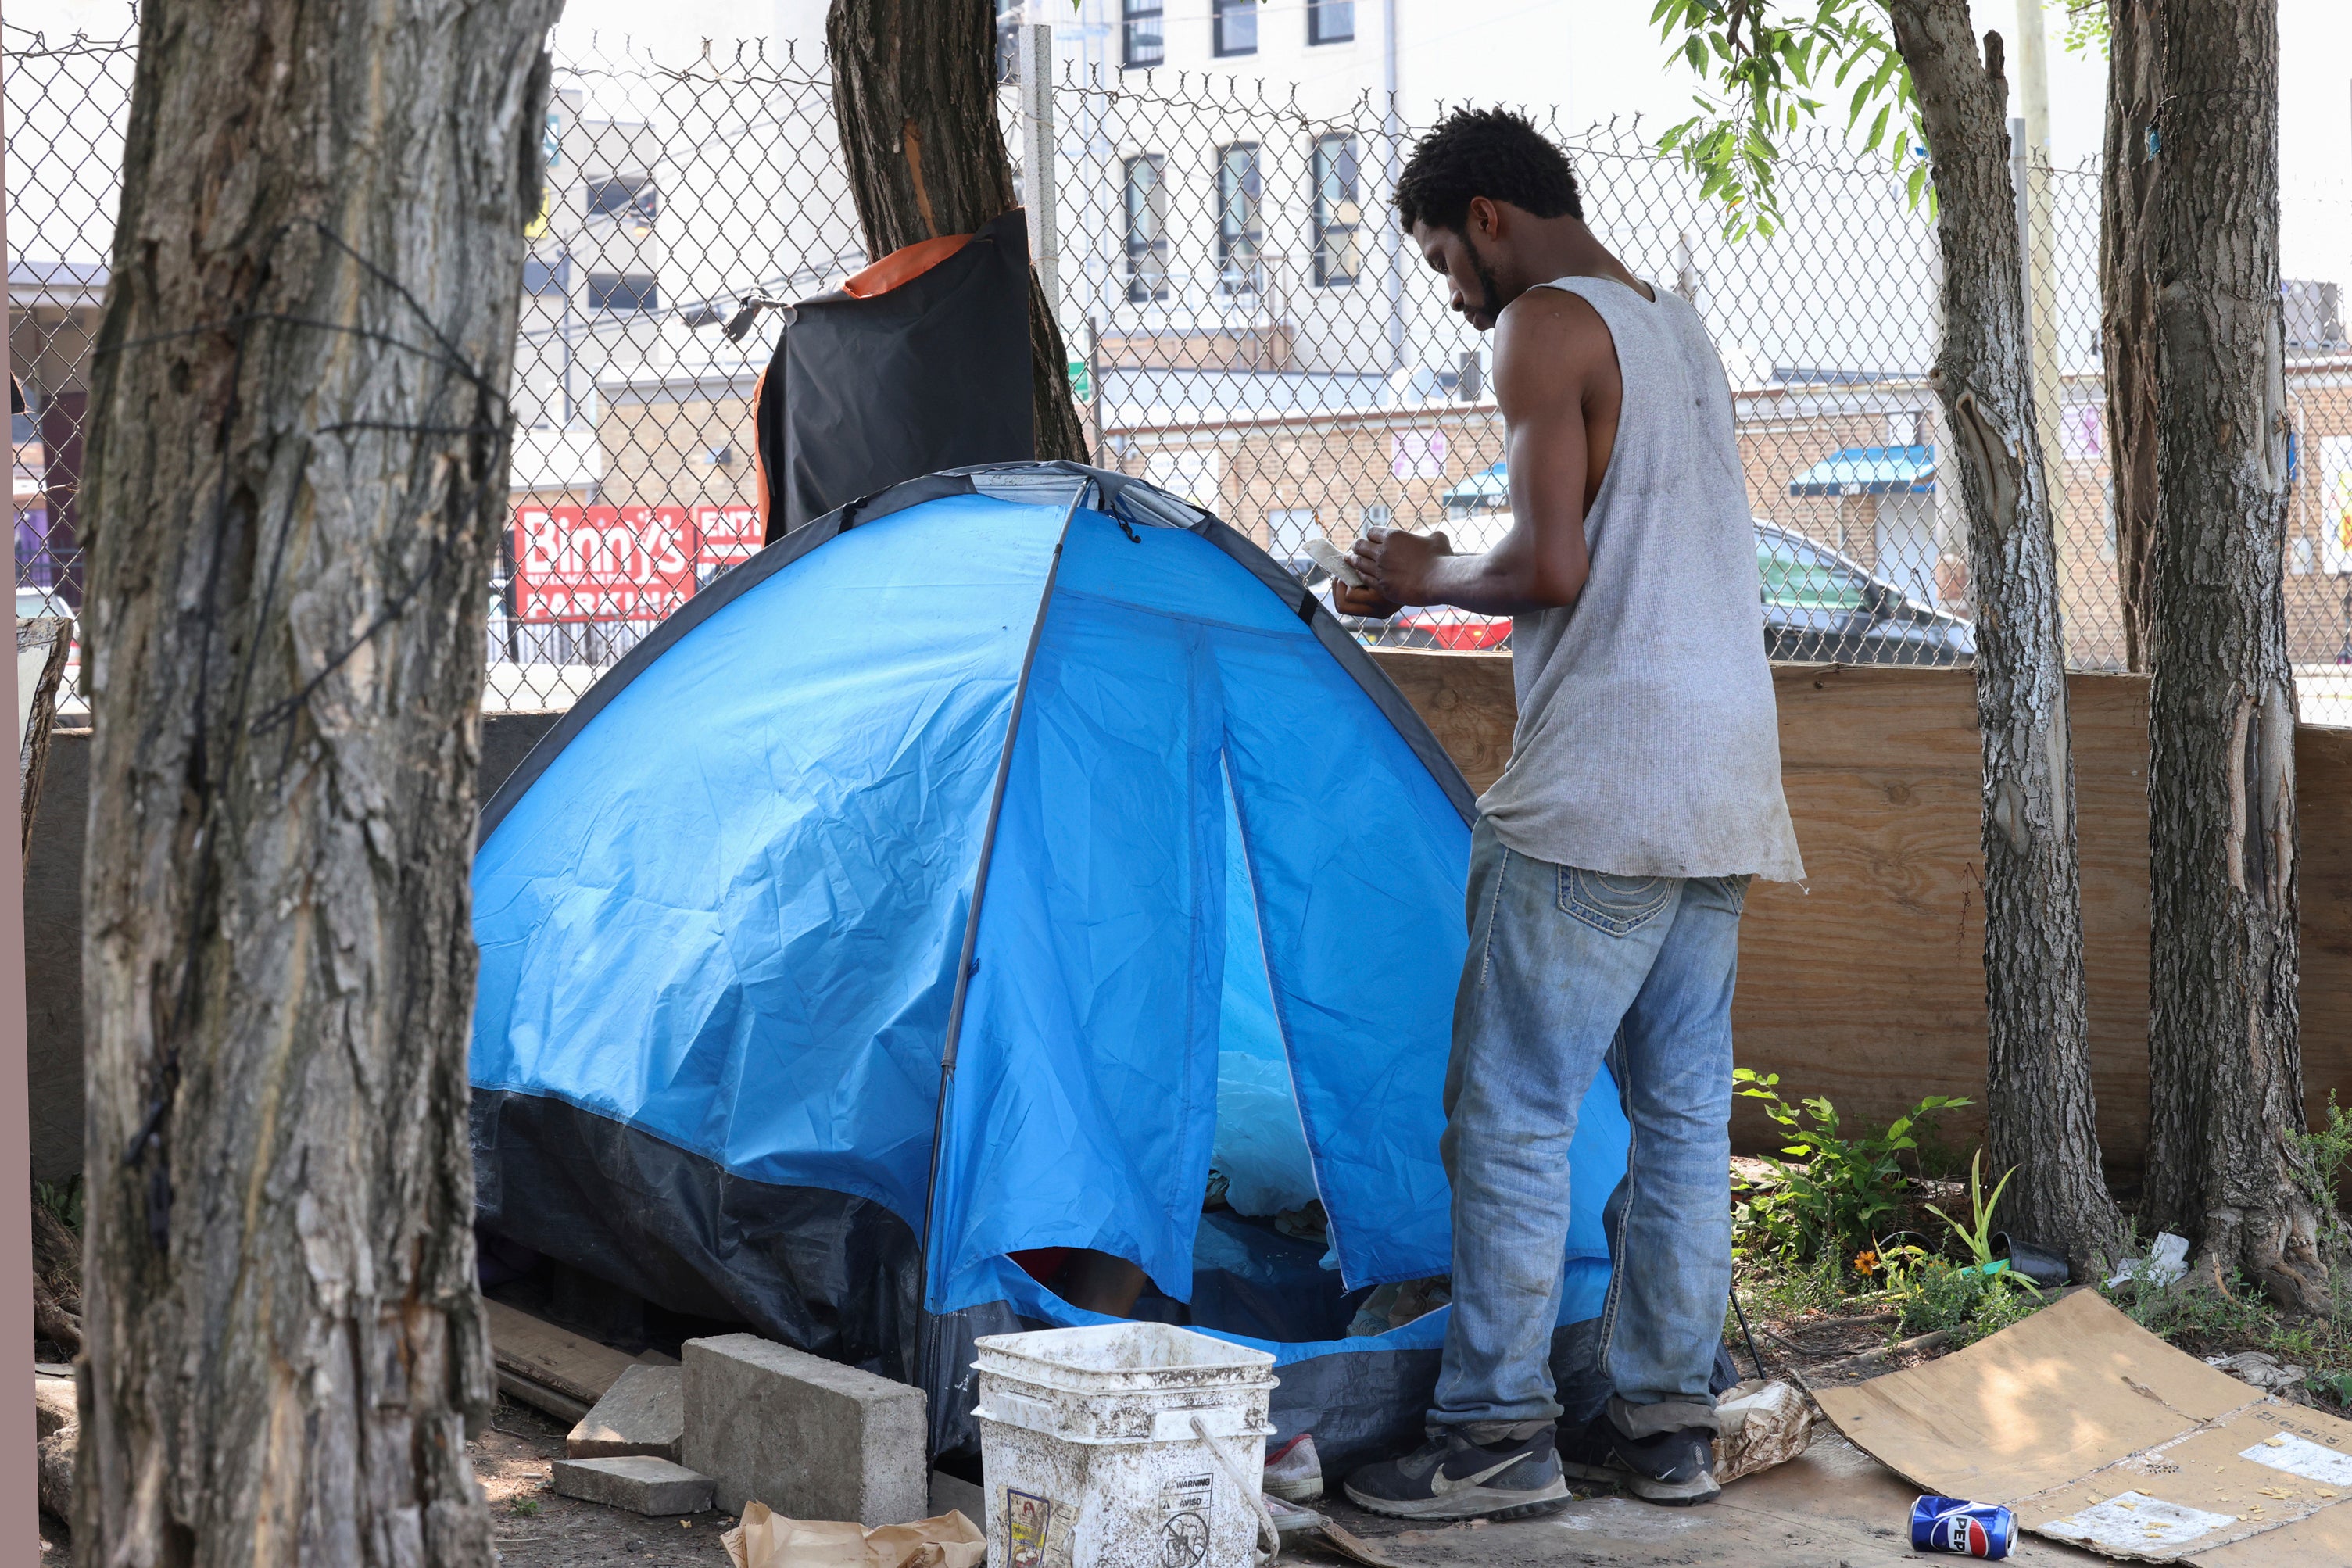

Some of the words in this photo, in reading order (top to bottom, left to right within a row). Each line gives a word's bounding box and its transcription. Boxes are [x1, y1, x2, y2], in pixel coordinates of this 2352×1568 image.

[524, 511, 685, 584] Binny's
[527, 591, 686, 619] PARKING
[1176, 1478, 1210, 1489] WARNING
[1179, 1498, 1202, 1508] AVISO
